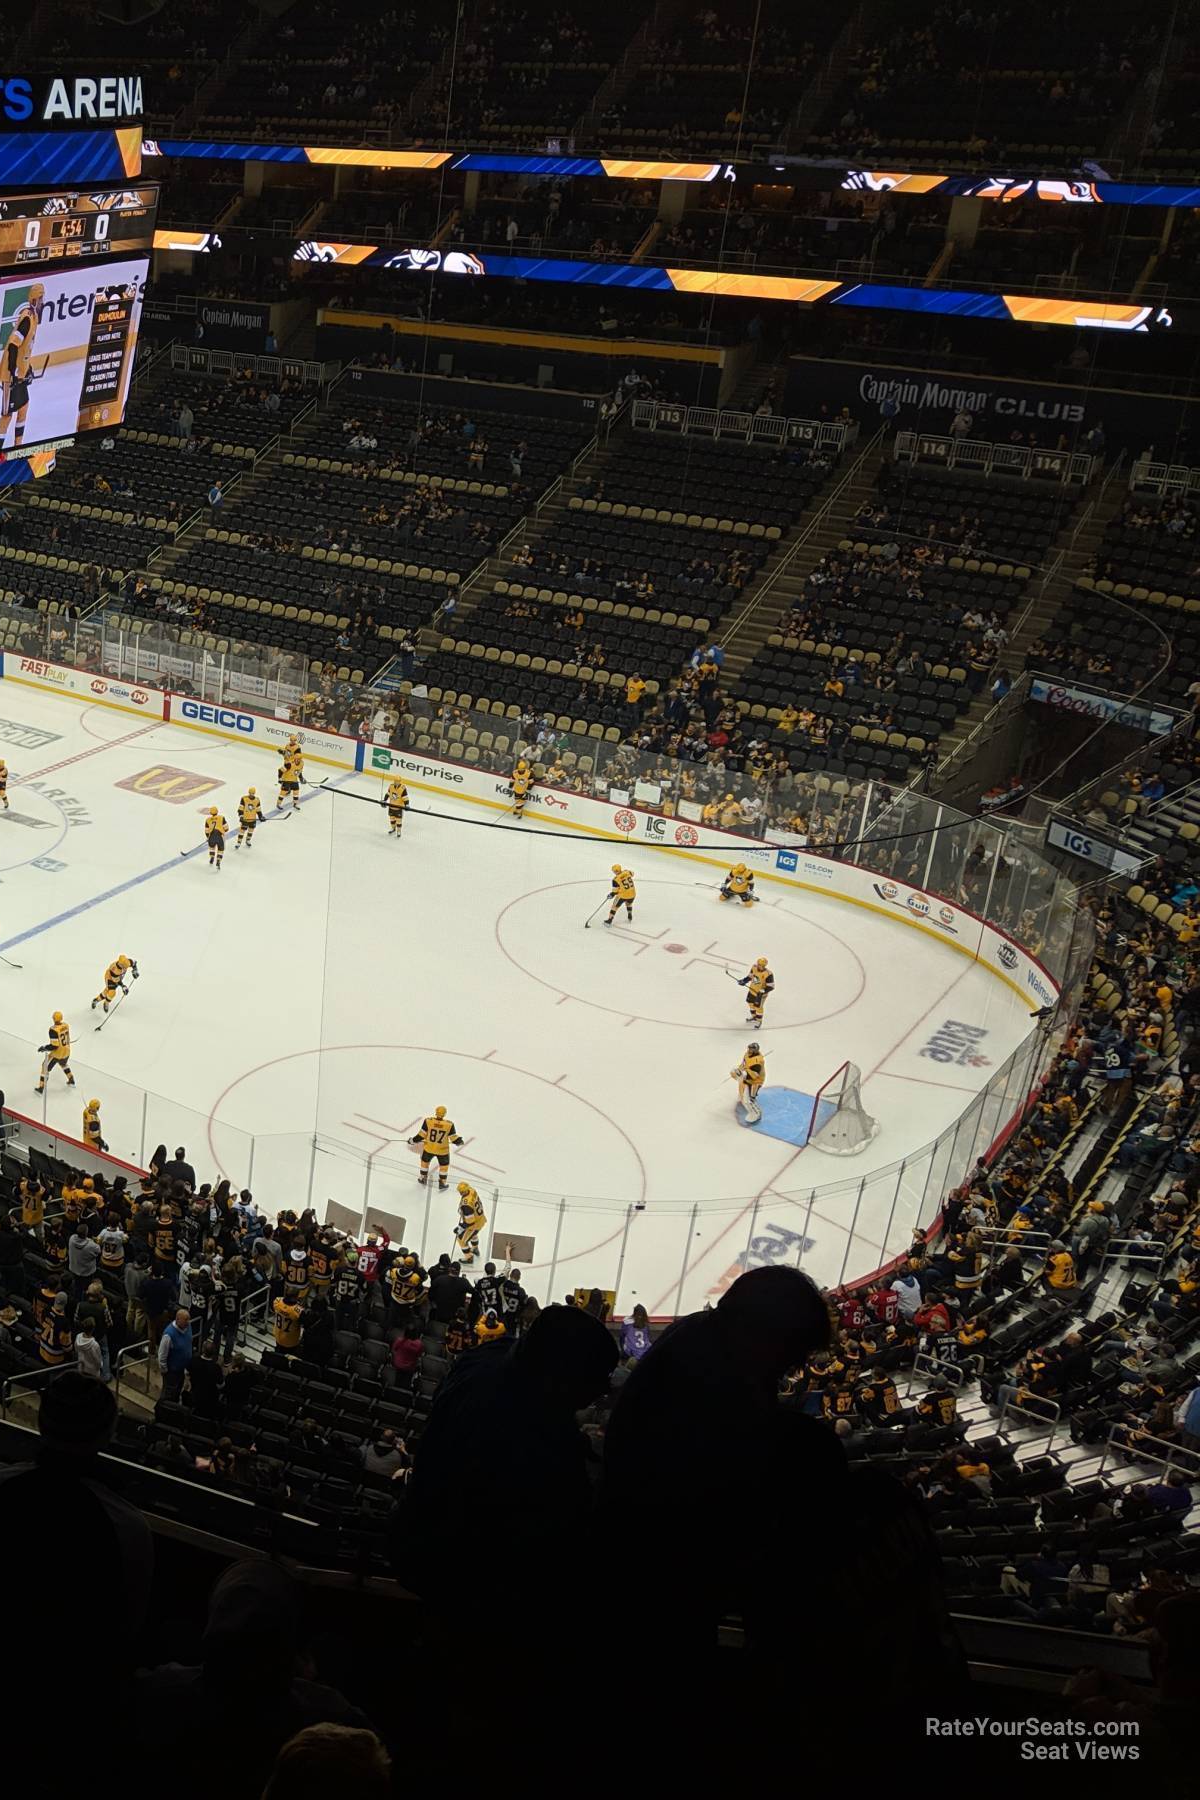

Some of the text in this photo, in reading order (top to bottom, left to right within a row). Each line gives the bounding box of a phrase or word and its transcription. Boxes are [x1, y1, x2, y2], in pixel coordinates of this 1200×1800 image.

[43, 76, 144, 120] ARENA
[25, 221, 40, 248] 0
[60, 222, 82, 237] 4:54
[95, 214, 110, 240] 0
[202, 307, 262, 330] Captain Morgan
[859, 374, 1085, 422] Captain Morgan CLUB
[659, 408, 680, 424] 113
[45, 438, 75, 453] ELECTRIC
[922, 441, 946, 458] 114
[1036, 455, 1062, 472] 114
[92, 681, 107, 692] DQ
[133, 692, 148, 703] DQ
[182, 701, 255, 733] GEICO
[266, 726, 344, 751] VECTO SECURITY
[376, 754, 464, 783] enterprise
[495, 783, 542, 804] Keynk
[29, 780, 93, 829] ARENA
[644, 832, 665, 841] LIGHT
[1064, 832, 1093, 856] IGS
[779, 855, 796, 866] IGS
[804, 862, 833, 875] IGS.COM
[907, 897, 930, 914] Gulf
[940, 909, 955, 920] Gulf
[428, 1129, 447, 1144] 87
[358, 1256, 378, 1273] 87
[287, 1267, 305, 1283] 30
[337, 1280, 358, 1296] 87
[392, 1281, 413, 1297] 87
[276, 1317, 293, 1333] 87
